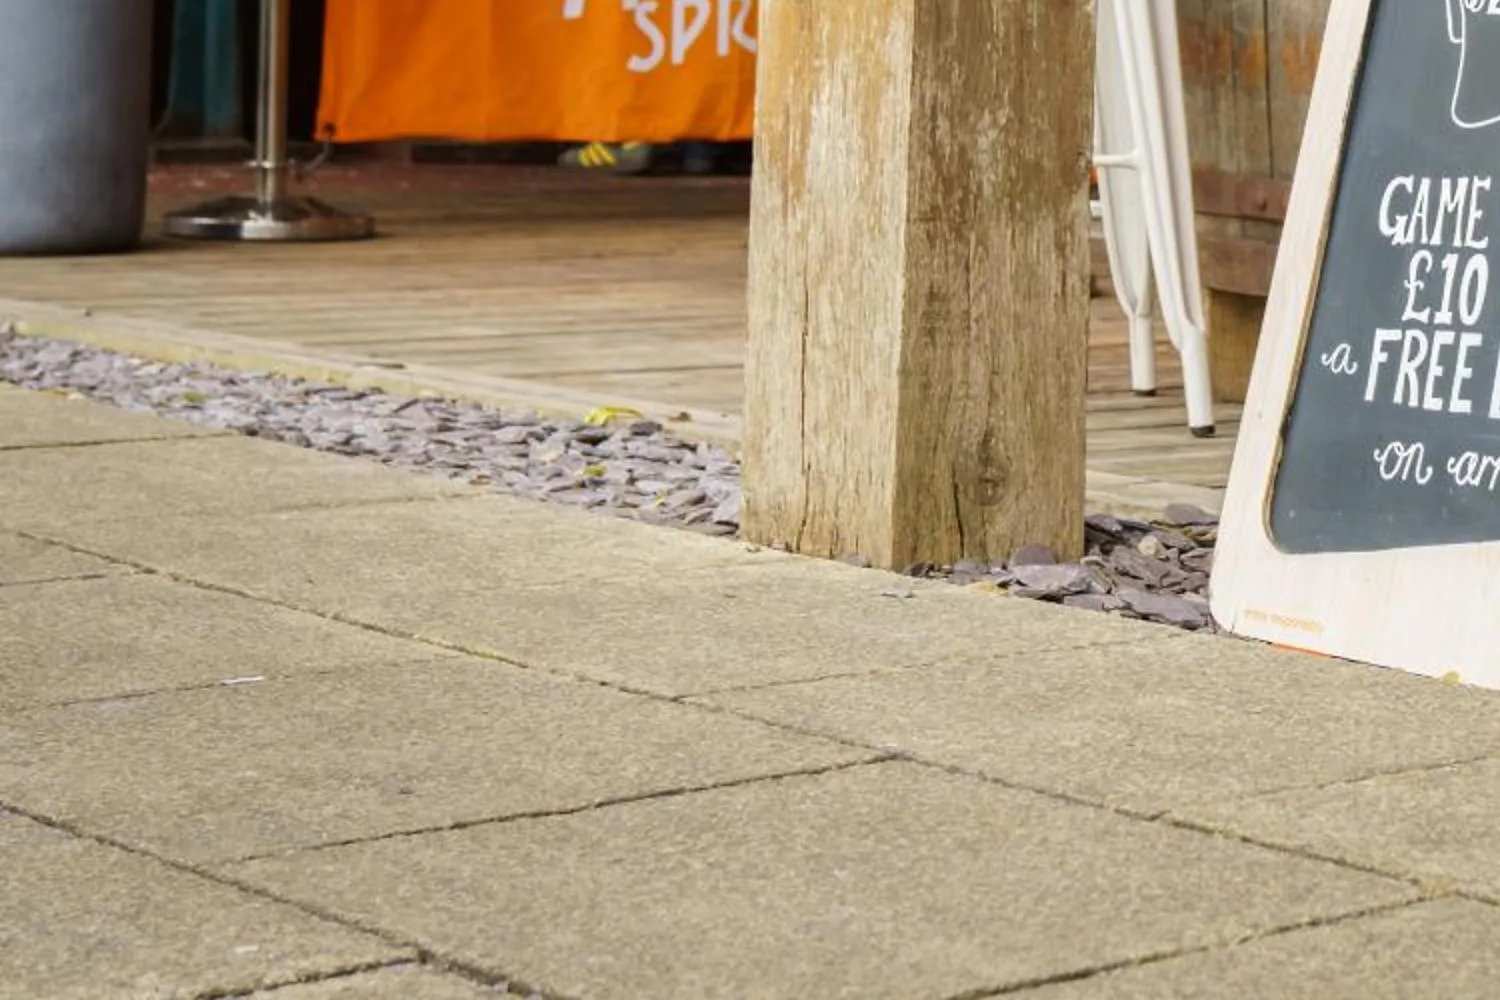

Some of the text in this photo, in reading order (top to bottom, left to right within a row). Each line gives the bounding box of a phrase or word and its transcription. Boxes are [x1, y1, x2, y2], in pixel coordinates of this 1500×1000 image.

[1378, 174, 1491, 248] GAME
[1400, 249, 1490, 325] £10
[1321, 342, 1359, 376] a
[1364, 328, 1484, 414] FREE
[1372, 440, 1434, 485] on
